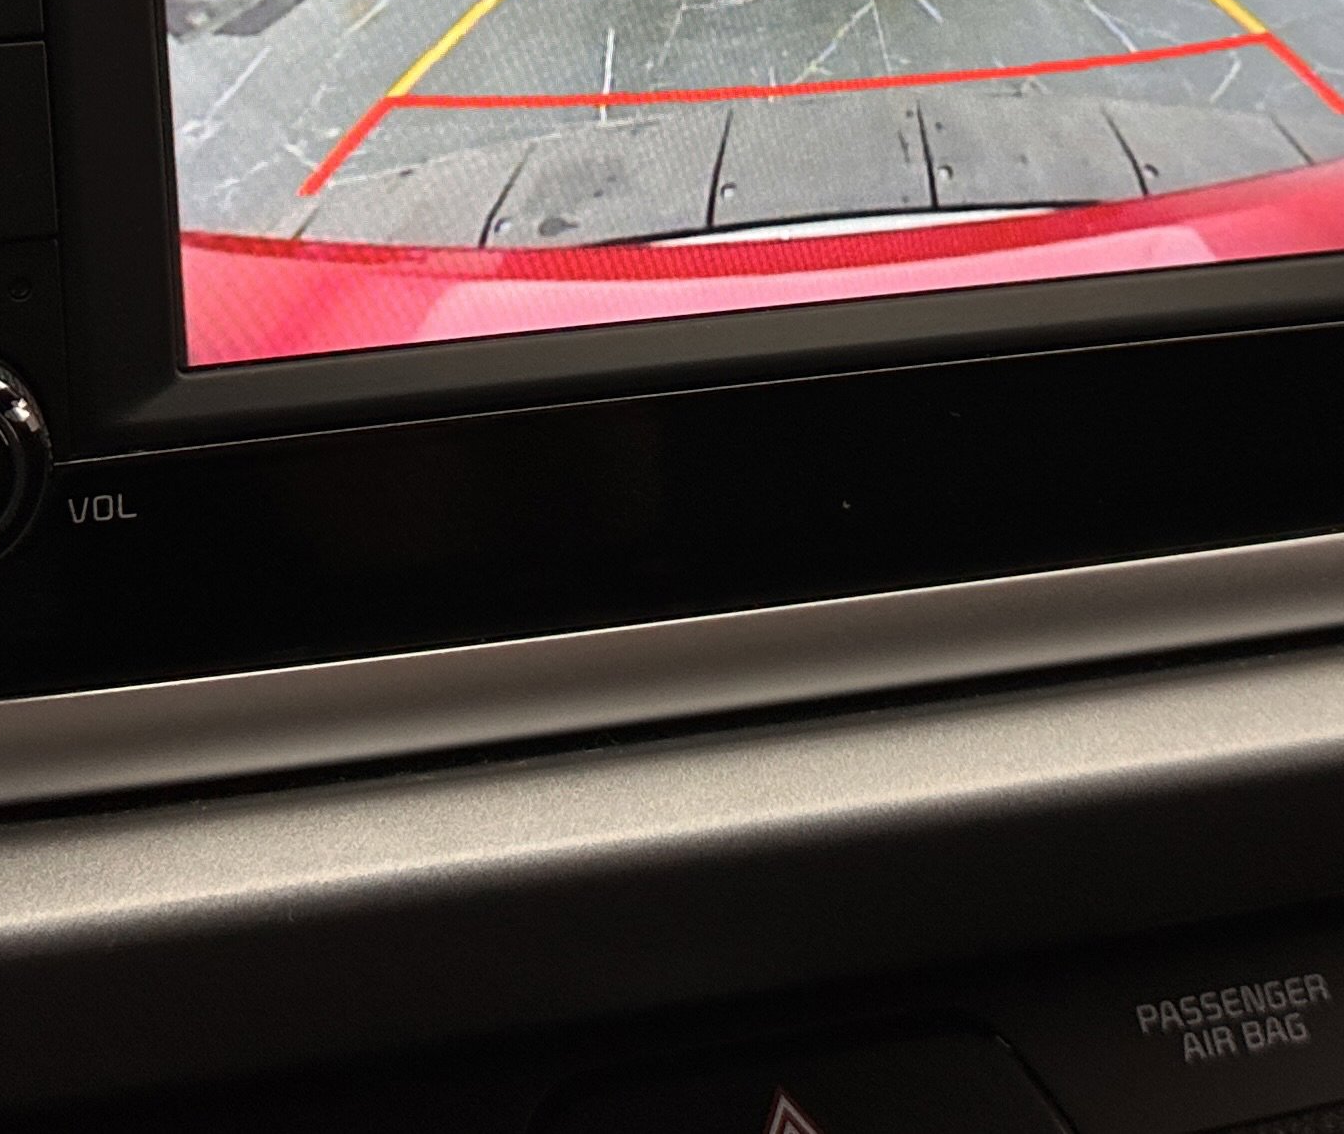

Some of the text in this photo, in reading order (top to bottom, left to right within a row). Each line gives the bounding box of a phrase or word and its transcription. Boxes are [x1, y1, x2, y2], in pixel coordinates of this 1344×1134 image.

[68, 493, 138, 525] VOL
[1136, 973, 1331, 1033] PASSENGER
[1181, 1012, 1310, 1063] AIR BAG
